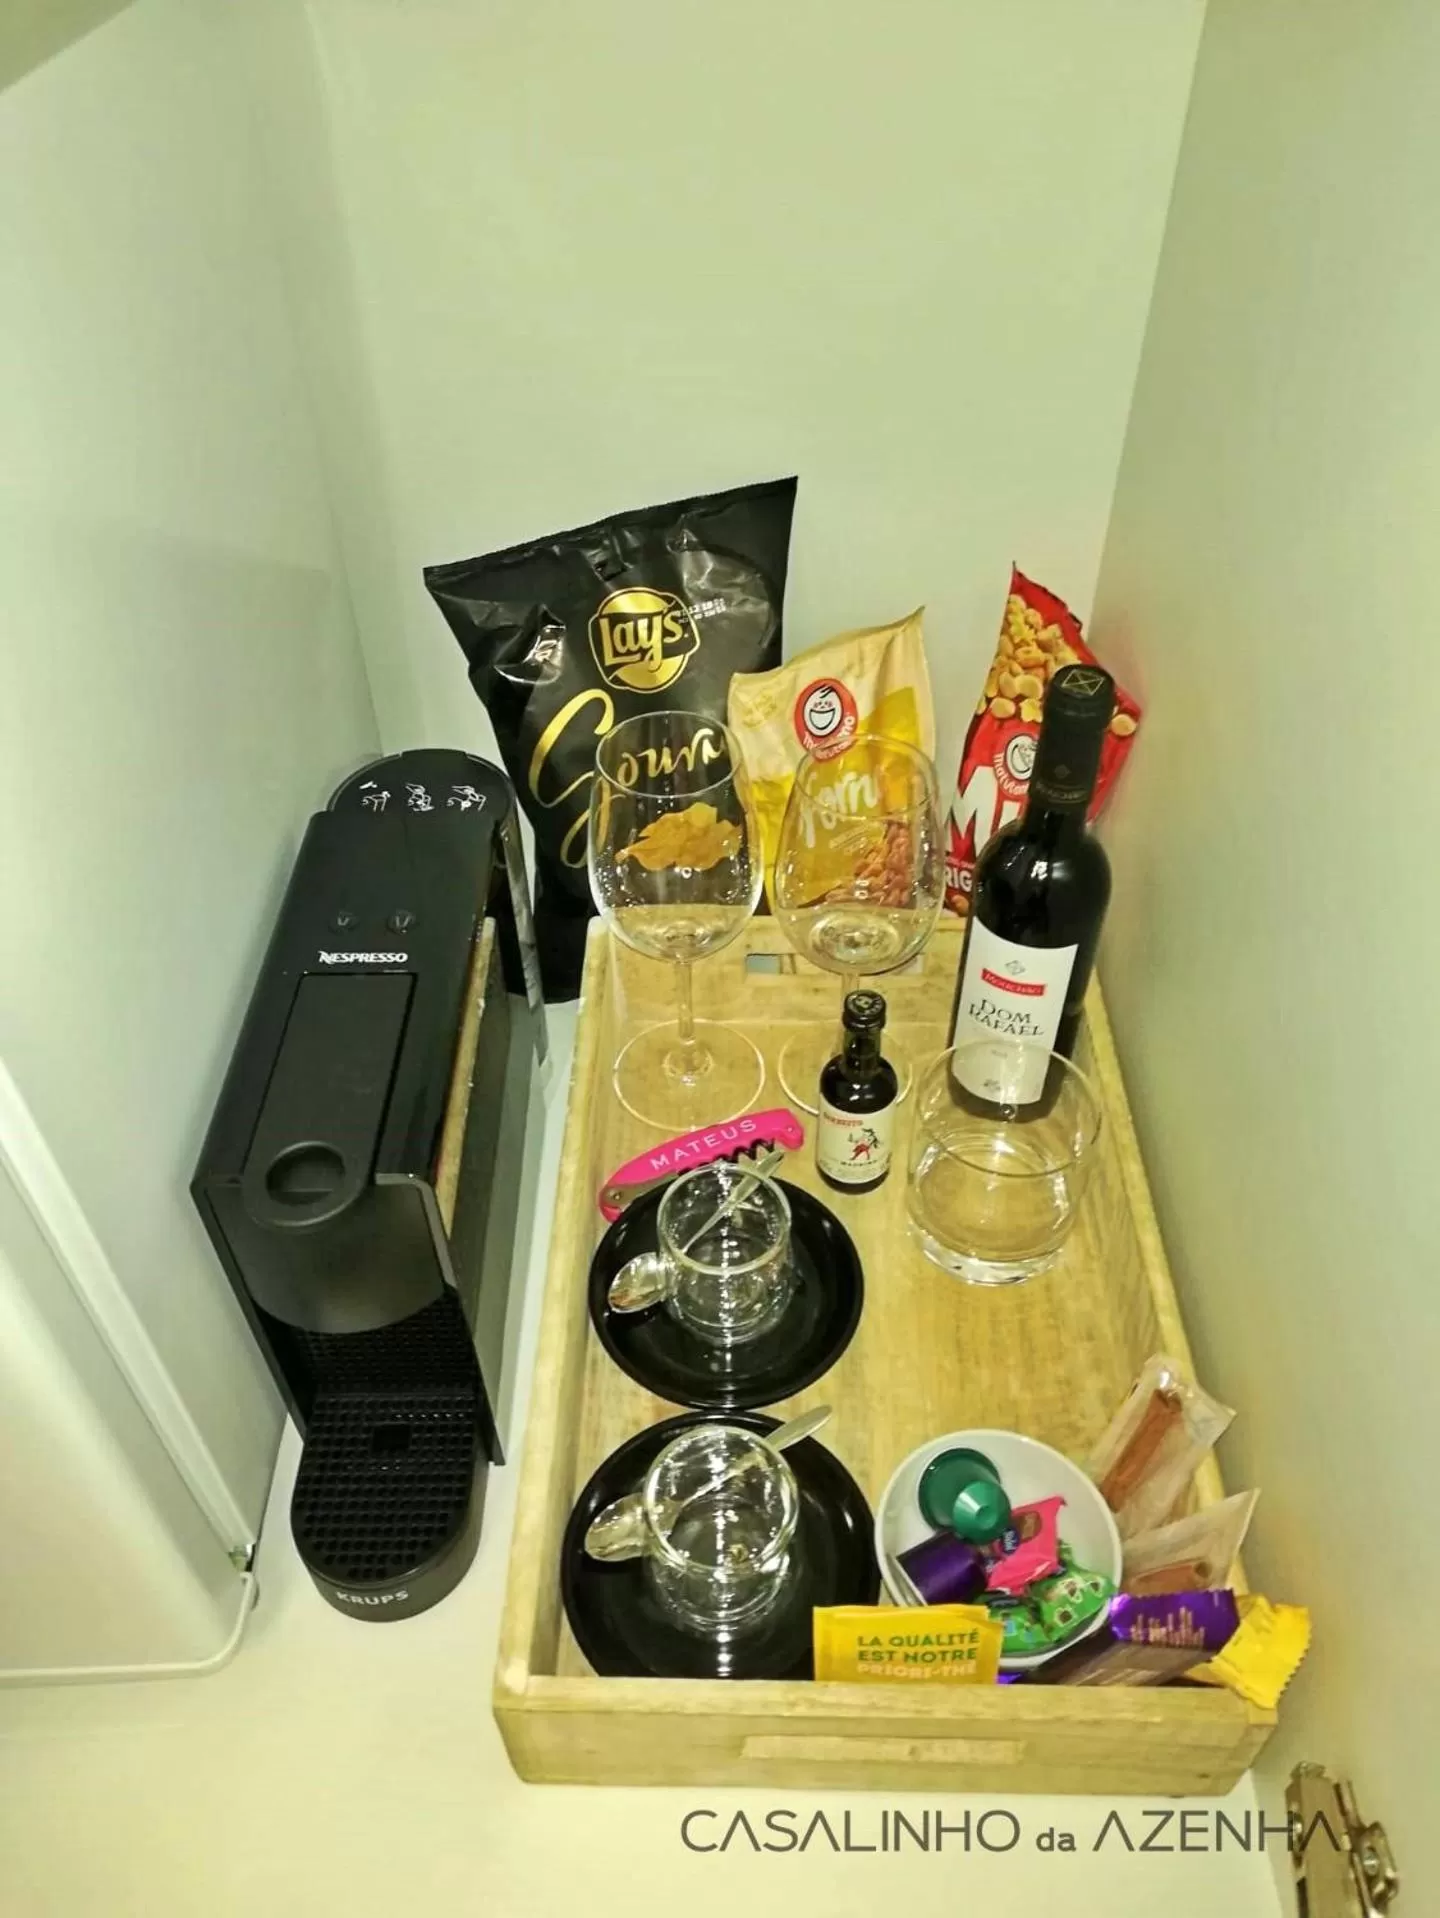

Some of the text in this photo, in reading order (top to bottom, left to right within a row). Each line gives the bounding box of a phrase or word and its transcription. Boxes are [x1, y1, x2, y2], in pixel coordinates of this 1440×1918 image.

[599, 604, 684, 673] Lay's
[318, 950, 409, 965] NESPRESSO
[969, 1003, 1045, 1036] RAFAEL
[980, 999, 1031, 1024] DOM
[650, 1119, 757, 1170] MATEUS
[336, 1590, 409, 1605] KRUPS
[857, 1629, 979, 1647] LA QUALITÉ
[858, 1648, 977, 1663] EST NOTRE
